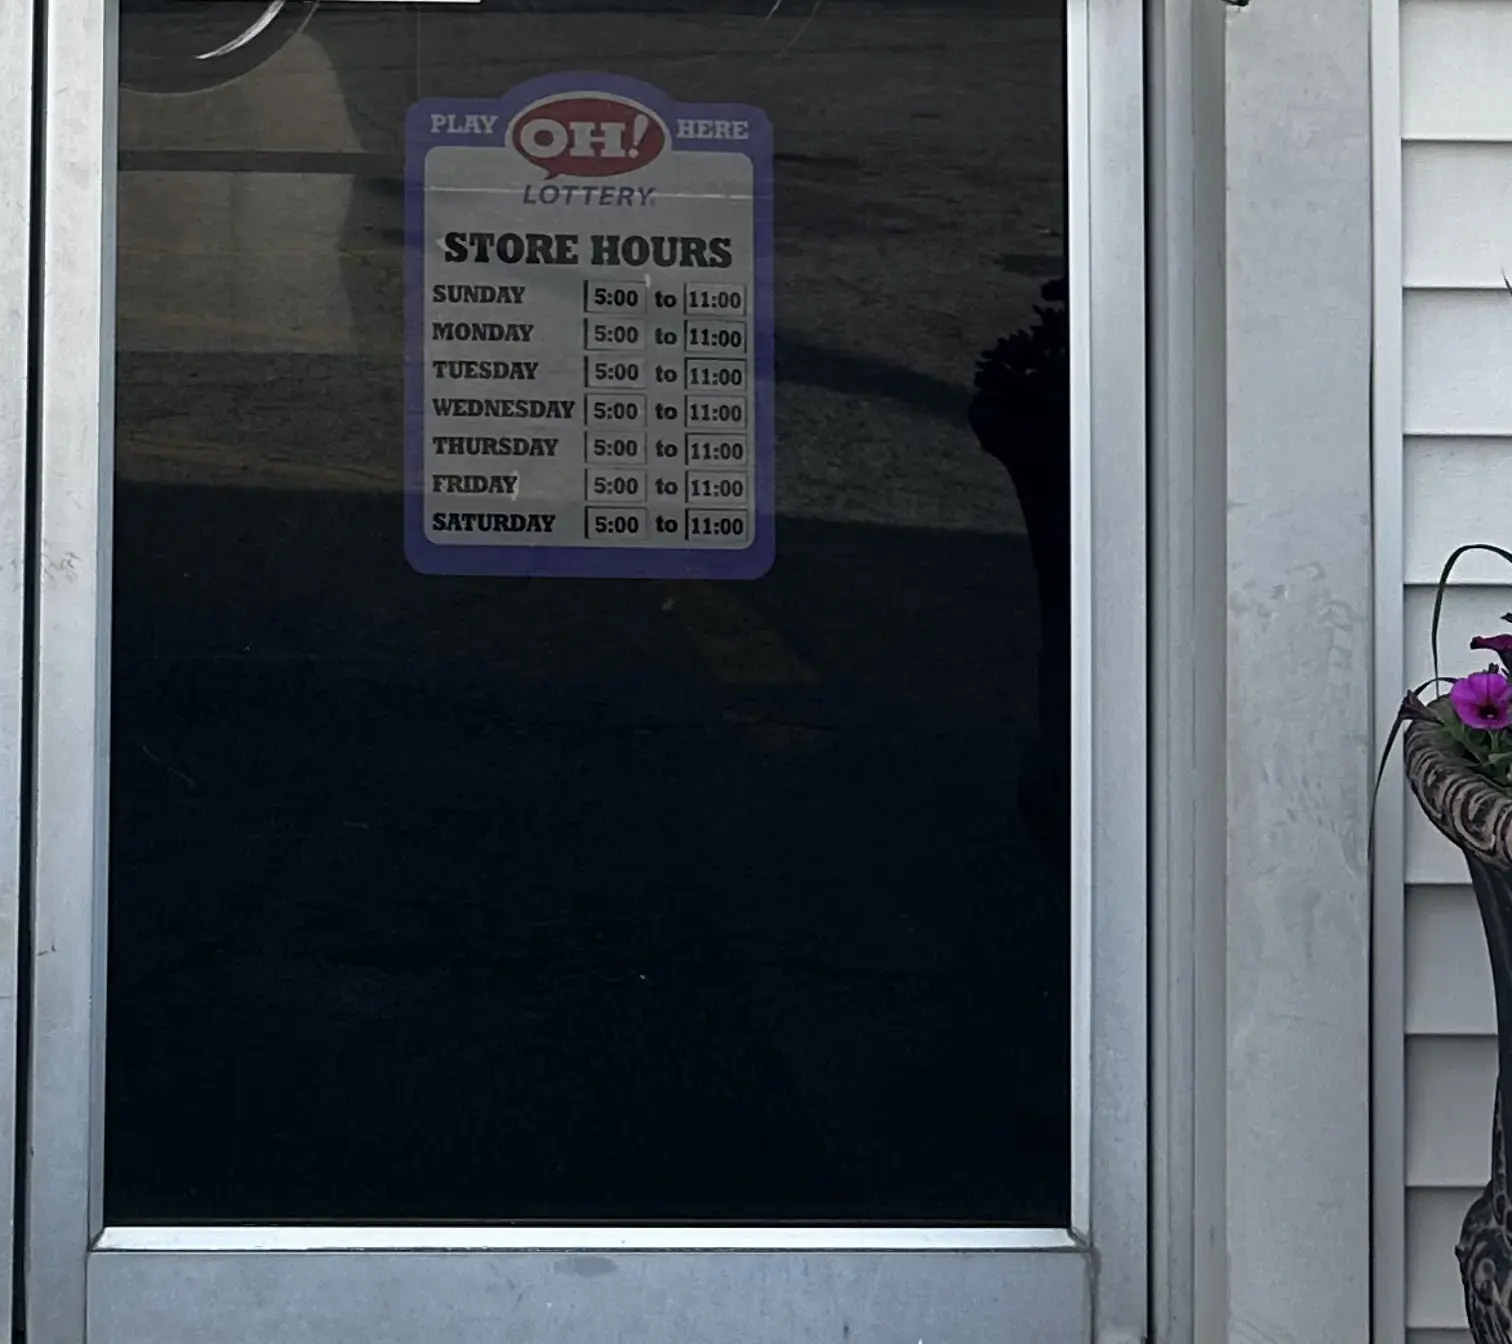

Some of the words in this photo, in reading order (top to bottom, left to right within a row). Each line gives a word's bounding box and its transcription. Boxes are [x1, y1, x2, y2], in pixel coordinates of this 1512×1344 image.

[431, 114, 498, 134] PLAY
[520, 112, 650, 159] OH!
[677, 119, 750, 140] HERE
[444, 232, 579, 265] STORE
[590, 234, 733, 269] HOURS
[432, 284, 525, 304] SUNDAY
[594, 289, 639, 308] 5:00
[655, 291, 678, 309] to
[689, 291, 743, 311] 11:00
[432, 322, 534, 342] MONDAY
[594, 326, 639, 345] 5:00
[655, 328, 678, 346] to
[689, 329, 743, 348] 11:00
[432, 360, 538, 380] TUESDAY
[594, 363, 639, 382] 5:00
[655, 365, 678, 383] to
[689, 365, 743, 385] 11:00
[432, 398, 575, 418] WEDNESDAY
[594, 401, 639, 420] 5:00
[655, 403, 678, 421] to
[689, 403, 743, 423] 11:00
[432, 436, 558, 456] THURSDAY
[594, 438, 639, 457] 5:00
[655, 440, 678, 458] to
[689, 440, 743, 460] 11:00
[432, 474, 518, 494] FRIDAY
[594, 476, 639, 495] 5:00
[655, 478, 678, 496] to
[689, 478, 743, 498] 11:00
[432, 512, 555, 532] SATURDAY
[594, 515, 639, 534] 5:00
[655, 517, 678, 535] to
[689, 517, 743, 537] 11:00
